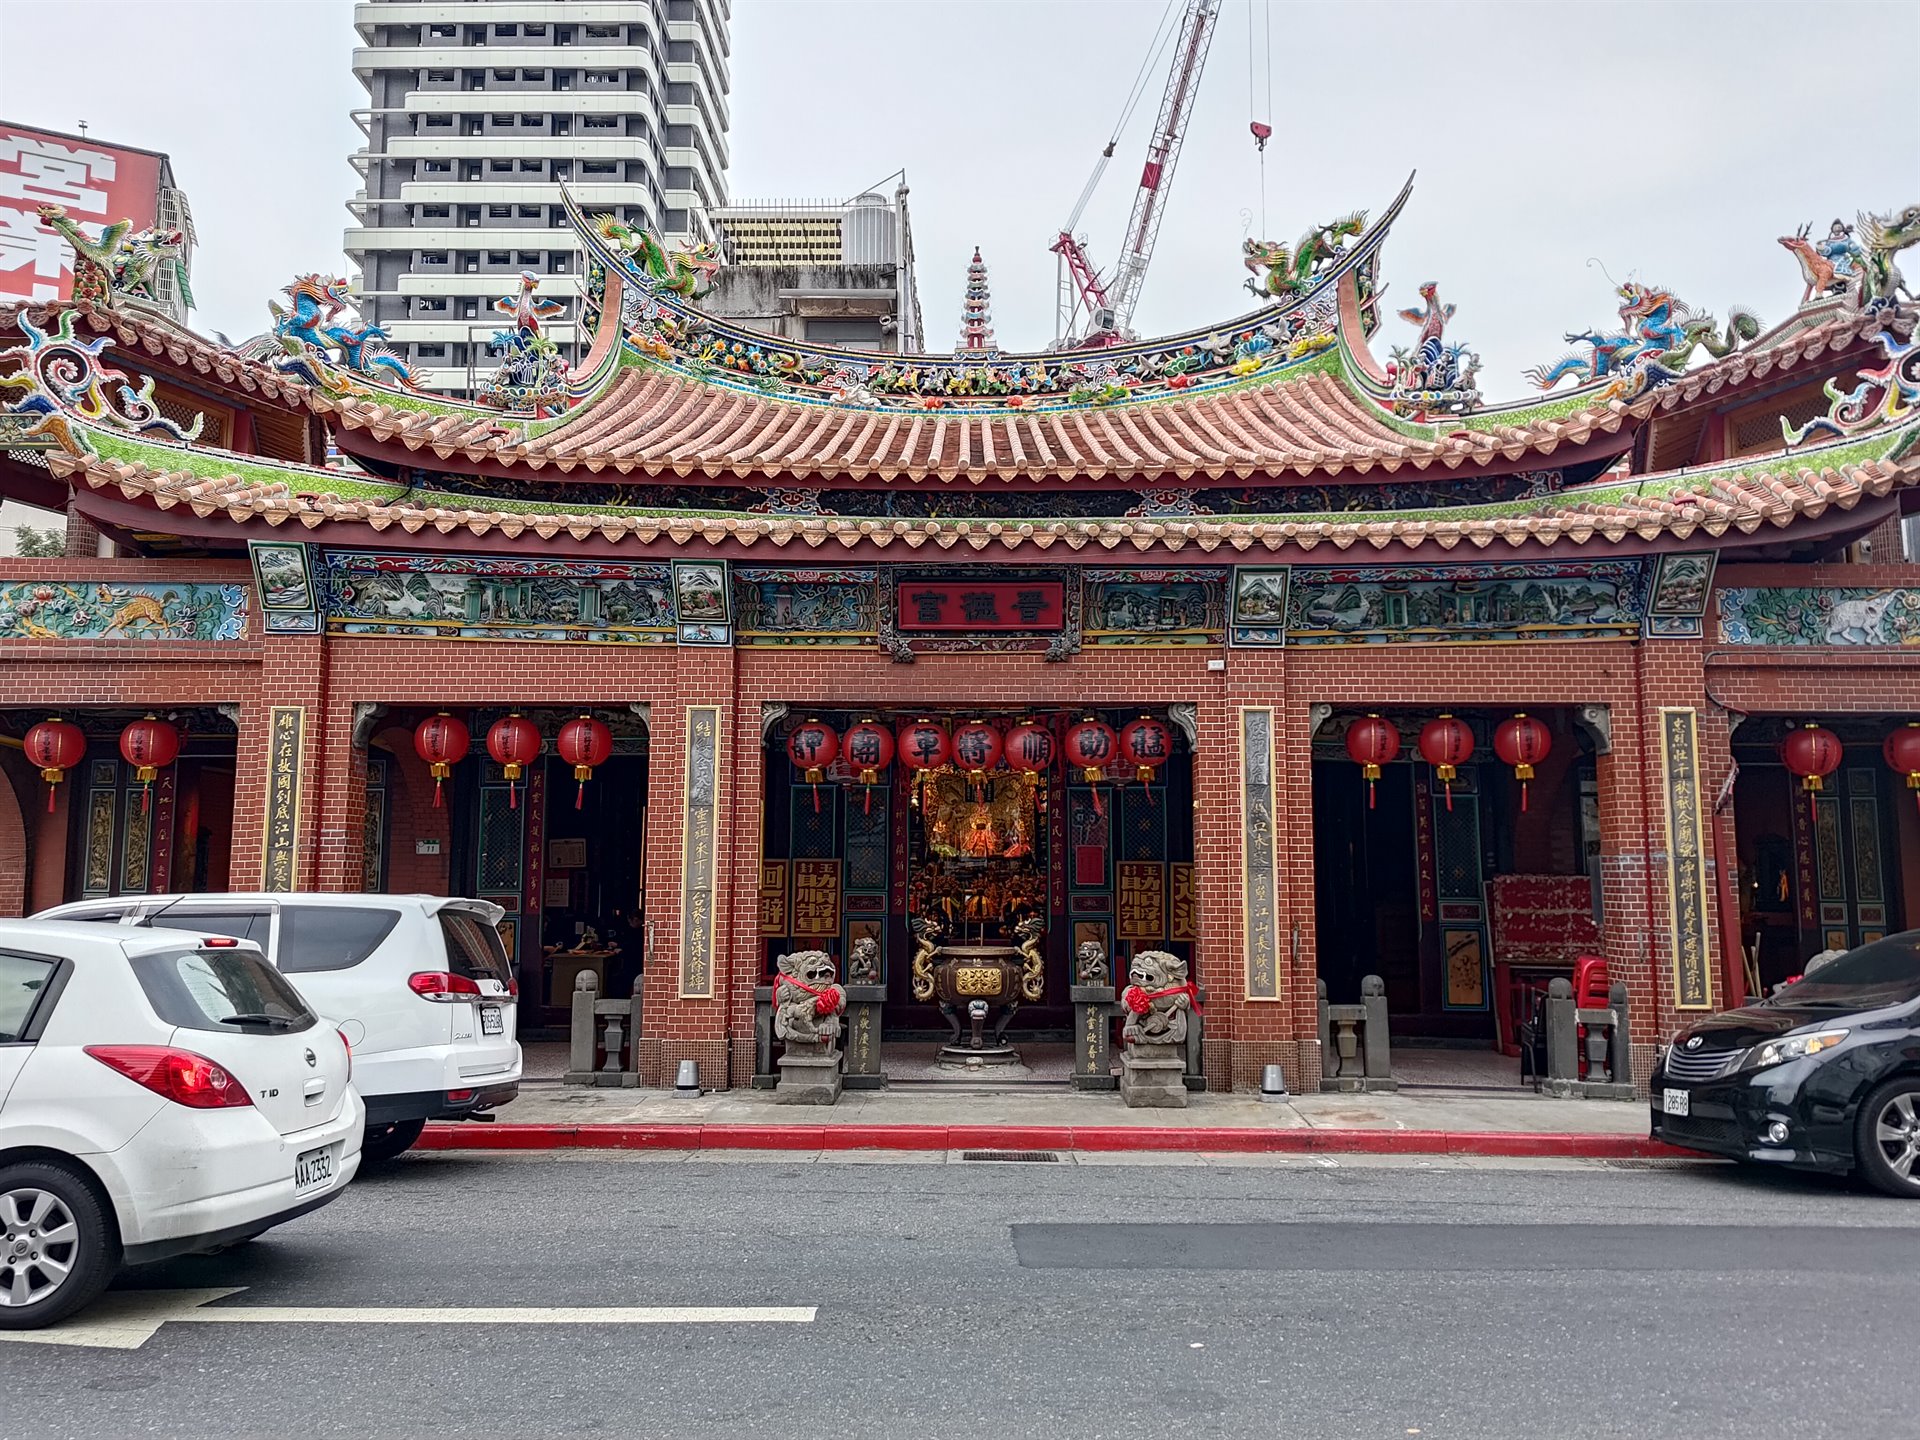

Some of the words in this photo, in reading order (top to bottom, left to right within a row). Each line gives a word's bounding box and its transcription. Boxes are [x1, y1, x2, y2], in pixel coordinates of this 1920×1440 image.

[911, 727, 940, 765] 軍
[958, 729, 992, 765] 將
[1022, 729, 1051, 766] 順
[796, 873, 837, 933] 助順將軍
[1120, 876, 1161, 936] 助順將軍
